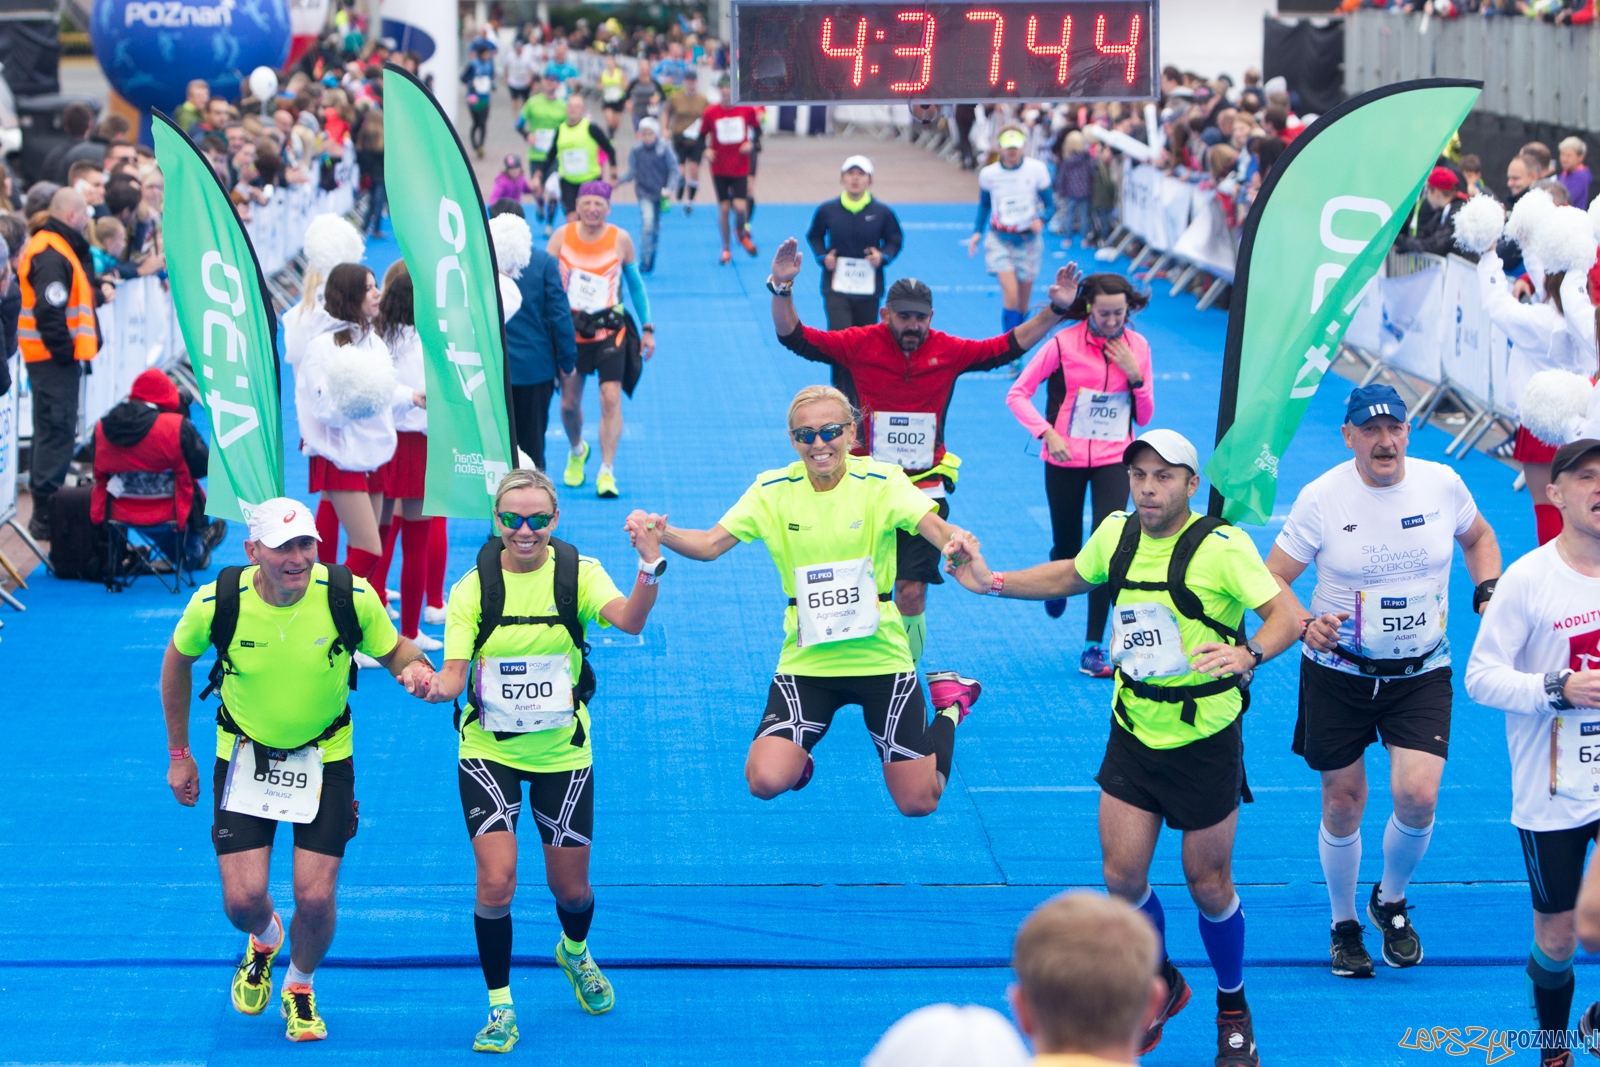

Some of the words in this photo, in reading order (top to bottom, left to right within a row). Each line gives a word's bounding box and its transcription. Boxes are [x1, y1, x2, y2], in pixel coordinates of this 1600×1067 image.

[1089, 406, 1118, 418] 1706
[887, 432, 926, 445] 6002
[849, 520, 863, 529] 4F
[1342, 524, 1358, 532] 4F
[1361, 543, 1389, 555] SIŁA
[1370, 548, 1429, 564] ODWAGA
[1361, 556, 1429, 575] SZYBKOŚĆ
[808, 586, 860, 609] 6683
[816, 609, 856, 620] Agnieszka
[1382, 611, 1427, 632] 5124
[313, 636, 329, 646] 4F
[1123, 628, 1162, 650] 6891
[1394, 633, 1417, 641] Adam
[501, 681, 553, 700] 6700
[514, 703, 542, 711] Anetta
[253, 769, 308, 789] 6699
[264, 788, 293, 799] Janusz
